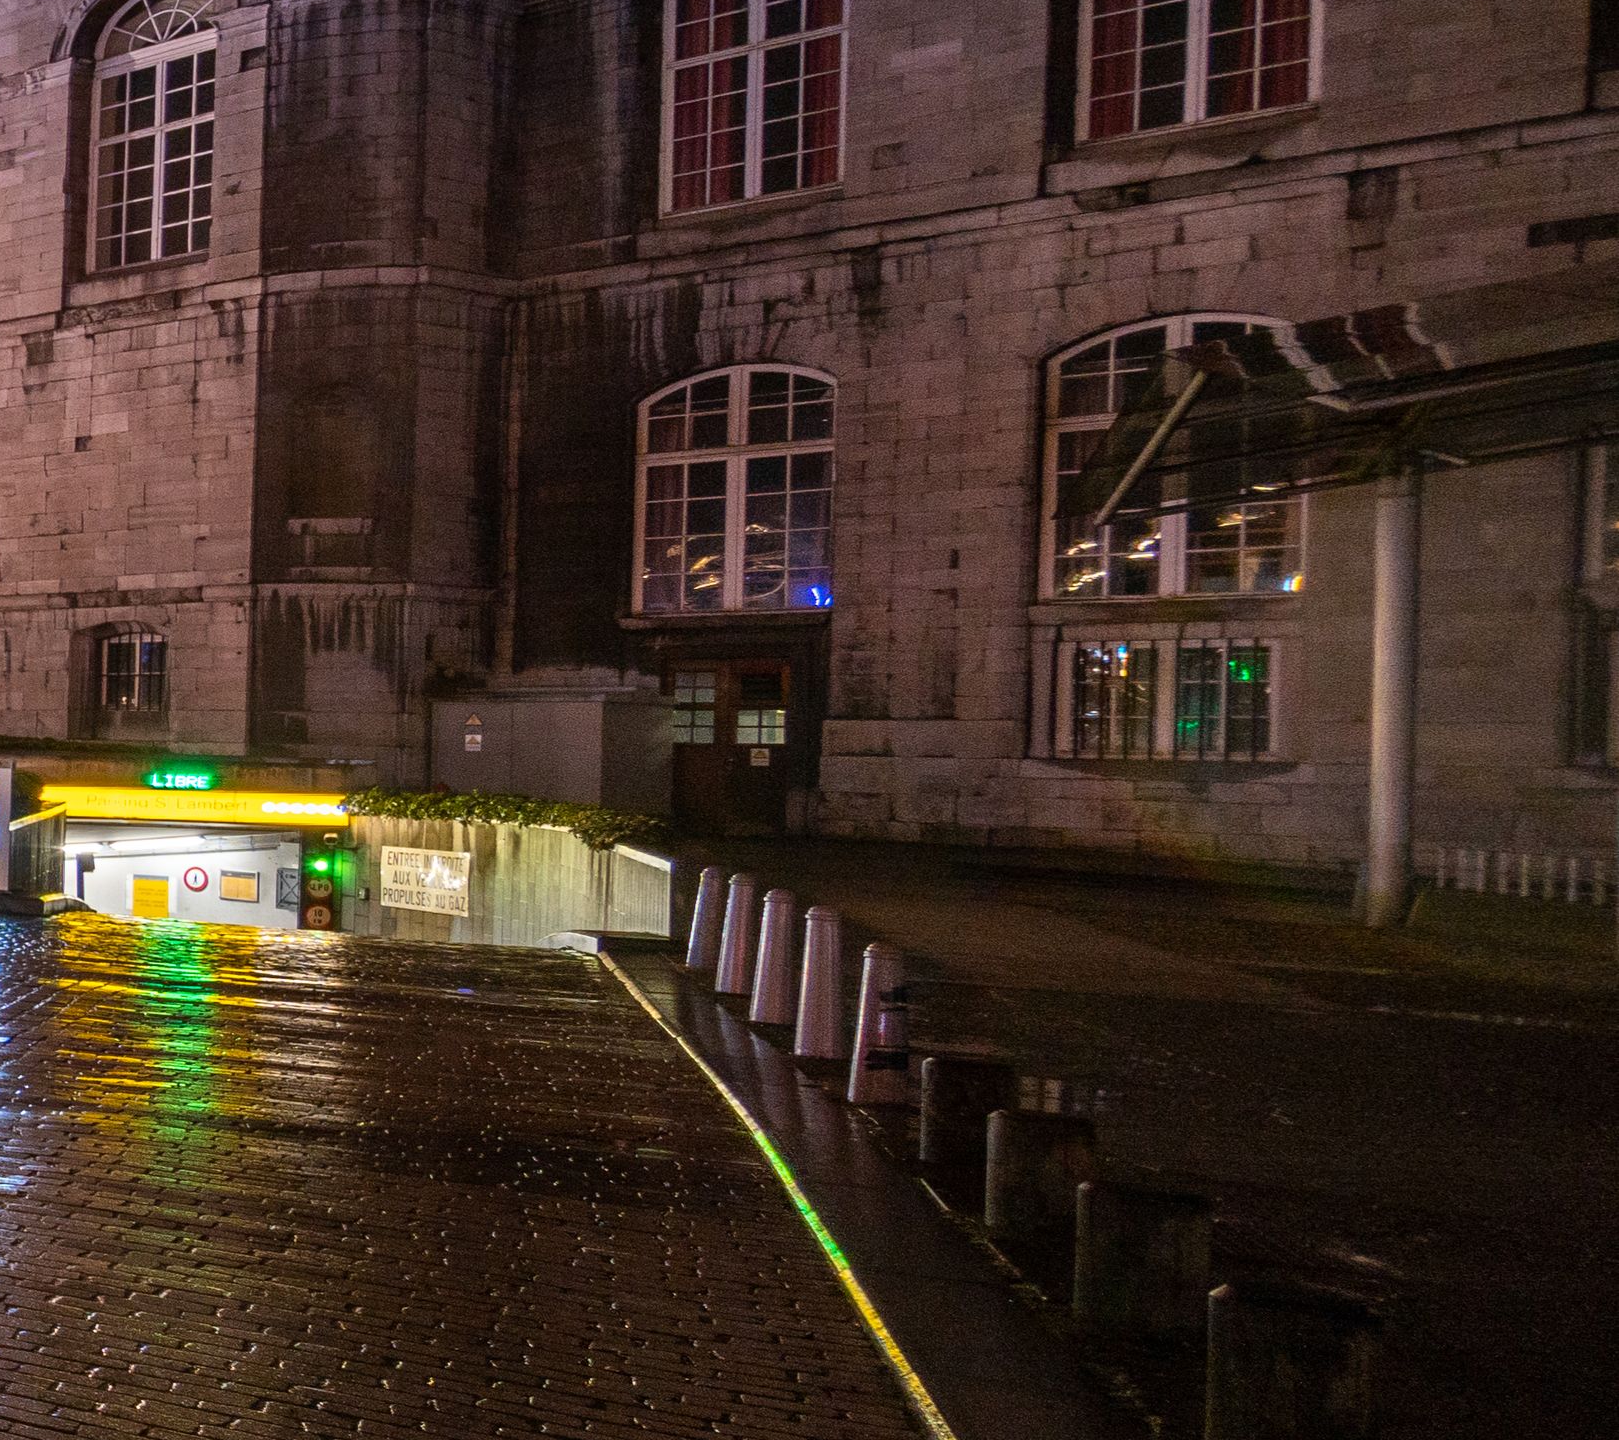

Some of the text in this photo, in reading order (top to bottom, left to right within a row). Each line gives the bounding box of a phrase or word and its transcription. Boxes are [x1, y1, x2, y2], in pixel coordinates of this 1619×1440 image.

[151, 773, 209, 789] LIBRE
[86, 794, 149, 809] Paring
[392, 870, 411, 886] AUX
[435, 895, 446, 909] AU
[448, 896, 466, 912] GAZ
